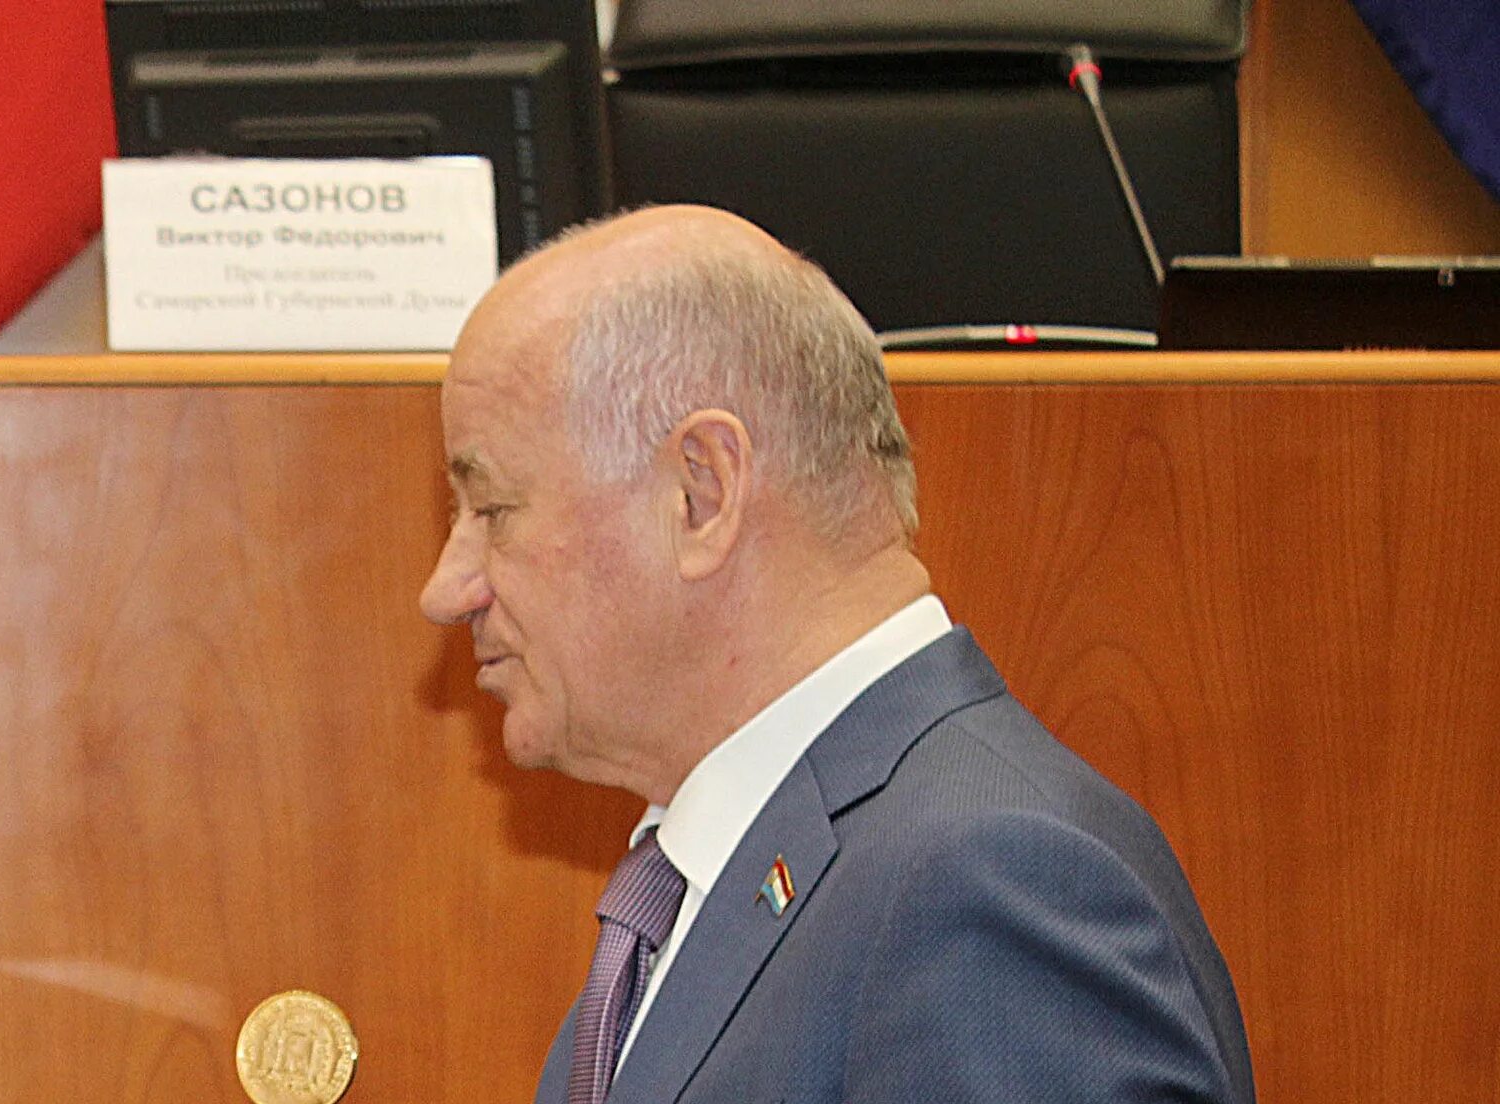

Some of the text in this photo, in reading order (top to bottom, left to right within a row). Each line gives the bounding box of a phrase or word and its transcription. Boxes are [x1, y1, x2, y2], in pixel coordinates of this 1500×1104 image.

[190, 184, 407, 214] САЗОНОВ
[156, 225, 445, 250] Виктор Федорович
